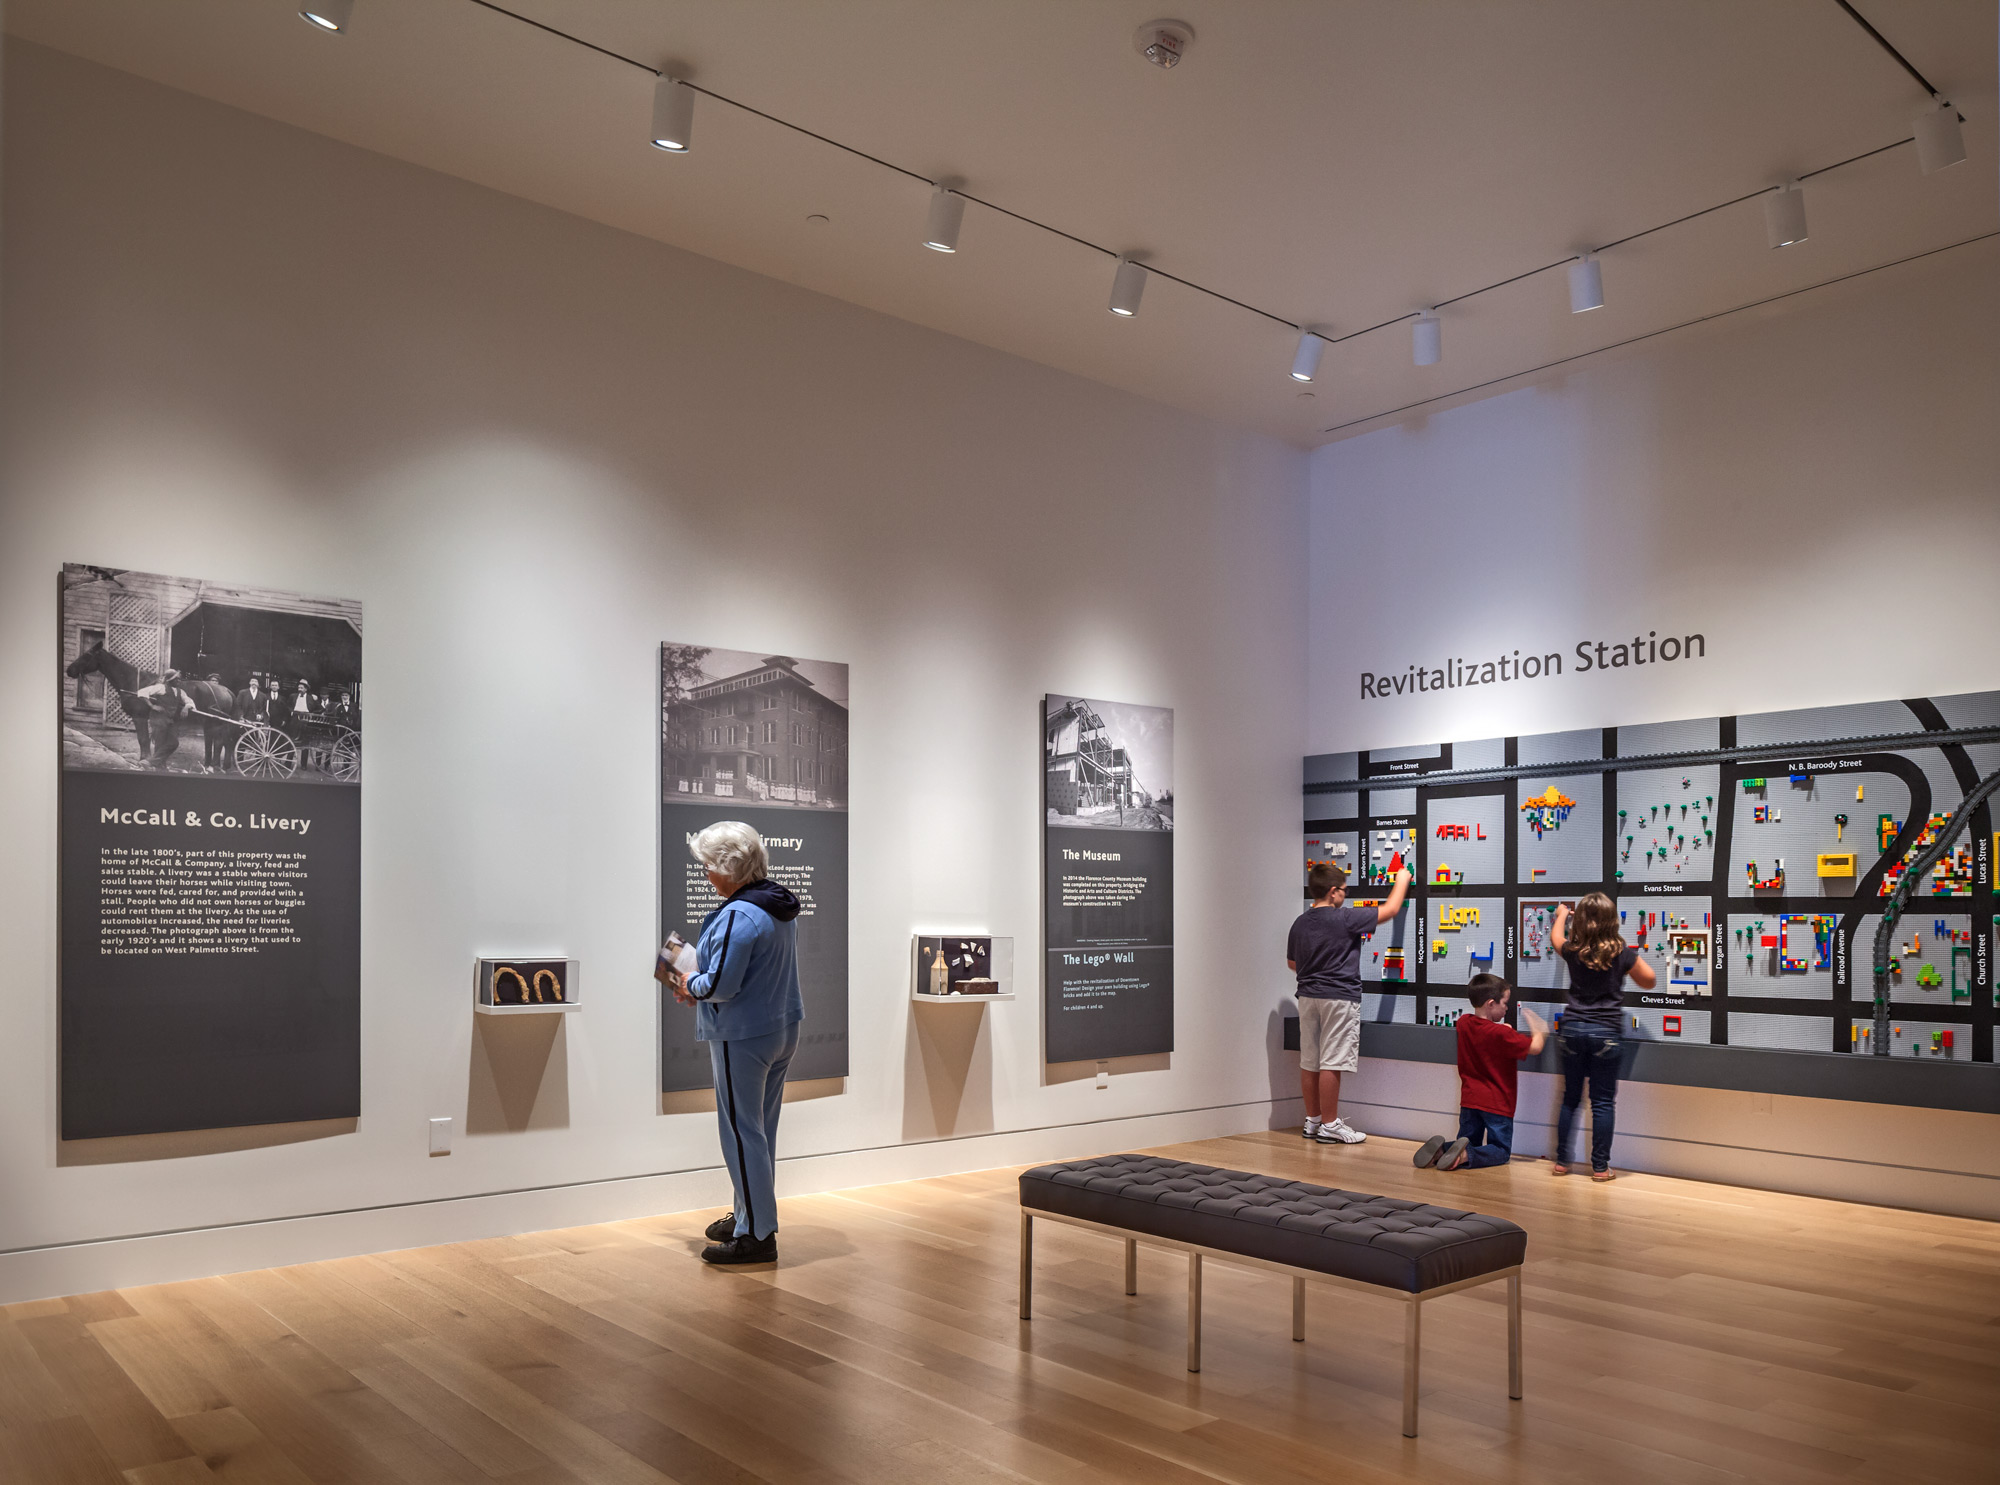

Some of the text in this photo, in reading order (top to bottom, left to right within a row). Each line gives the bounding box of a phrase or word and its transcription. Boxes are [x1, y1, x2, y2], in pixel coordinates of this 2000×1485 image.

[1361, 631, 1705, 699] Revitalization Station
[1807, 761, 1837, 770] Baroody
[101, 808, 310, 834] McCall & Co. Livery
[760, 834, 803, 851] irmary
[152, 848, 183, 857] 1800's,
[1063, 849, 1121, 861] The Museum
[184, 859, 226, 868] Company,
[236, 860, 262, 869] livery,
[1978, 838, 1986, 884] Lucas Street
[168, 868, 193, 877] livery
[159, 888, 176, 896] fed,
[240, 889, 277, 897] provided
[127, 897, 156, 906] People
[274, 898, 305, 907] buggies
[205, 907, 231, 916] livery.
[1440, 904, 1480, 924] Liam
[169, 926, 219, 935] photograph
[101, 937, 123, 946] early
[224, 936, 248, 944] livery
[1063, 954, 1080, 965] The
[1114, 952, 1134, 963] Wall
[1716, 945, 1724, 969] Dargan
[1978, 933, 1986, 986] Church Street
[1837, 956, 1845, 984] Railroad
[1665, 996, 1685, 1004] Street
